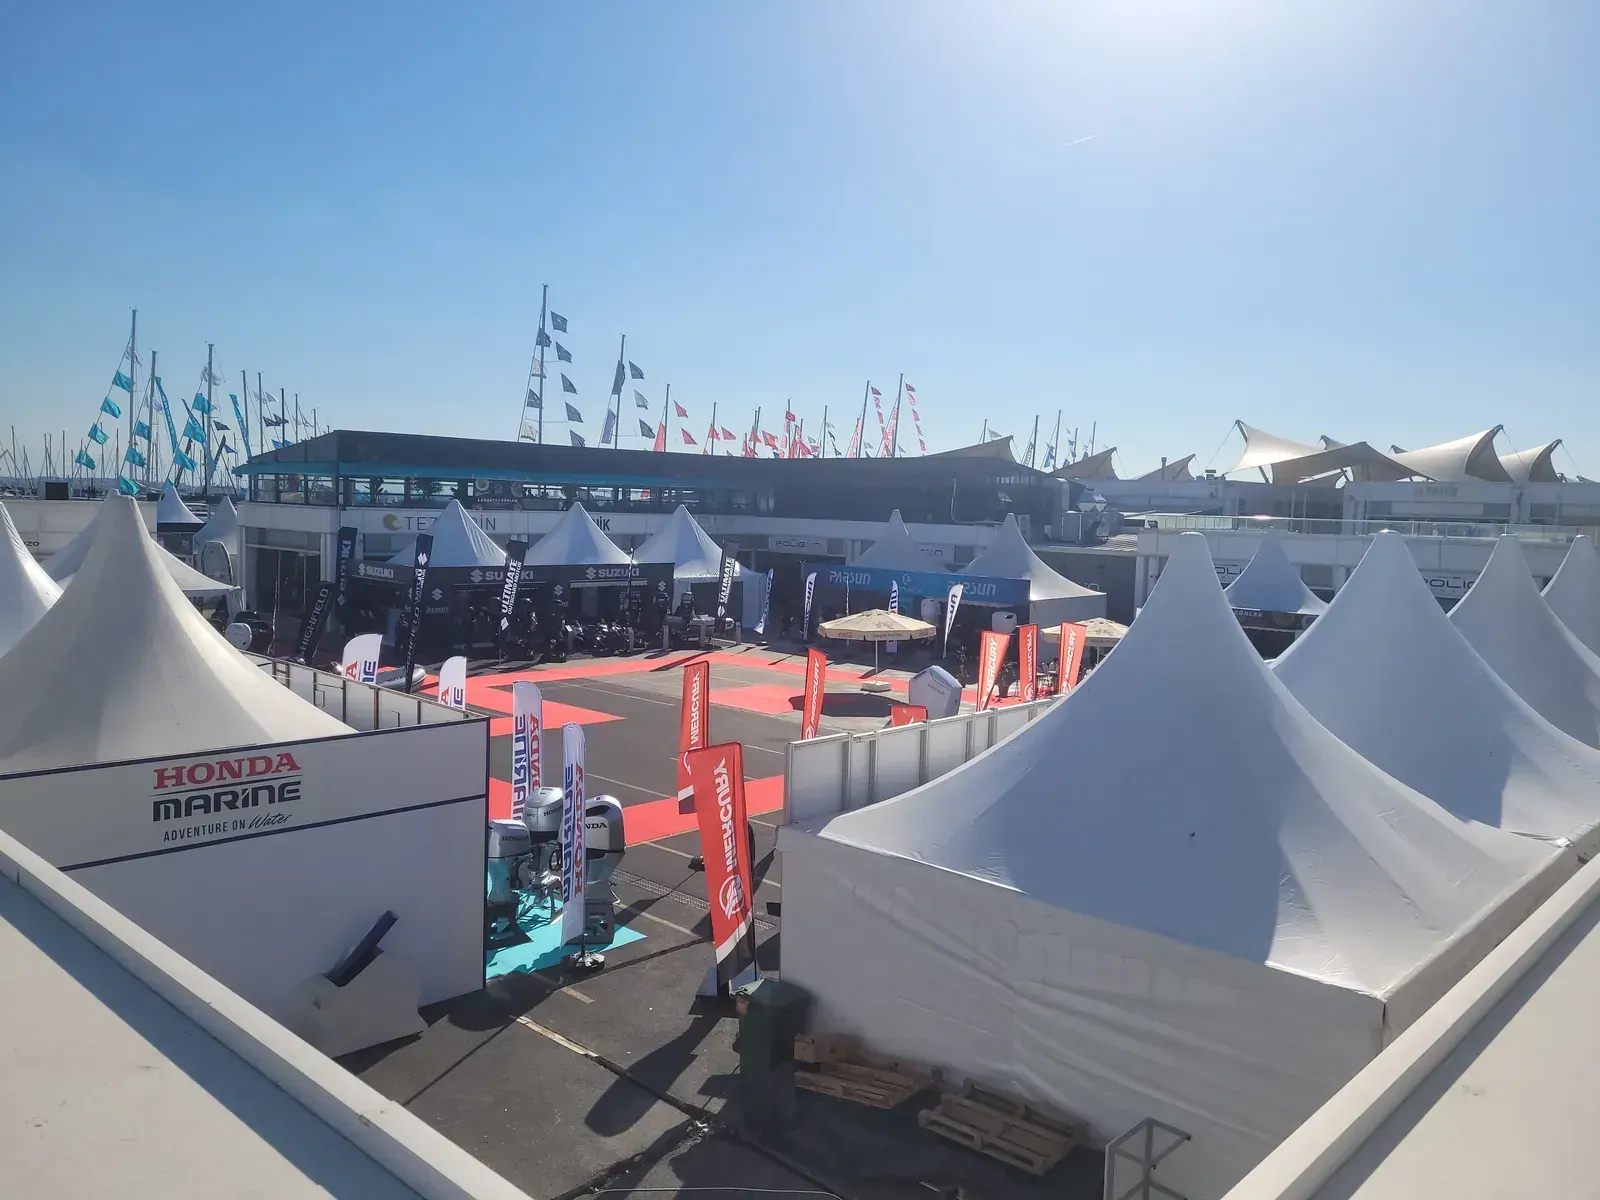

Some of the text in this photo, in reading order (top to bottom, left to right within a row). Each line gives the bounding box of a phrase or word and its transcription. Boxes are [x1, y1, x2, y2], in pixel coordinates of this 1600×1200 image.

[366, 566, 394, 578] SUZUKI
[484, 570, 534, 580] SUKI
[501, 559, 519, 614] ULTIMATE
[598, 567, 640, 577] SUZUKI
[719, 556, 735, 603] ULTIMATE
[946, 580, 996, 597] PRSUN
[300, 588, 329, 653] HIGHFIELD
[986, 638, 1000, 694] MERCURY
[1064, 628, 1078, 681] MERCURY
[810, 657, 820, 723] MERCURY
[153, 752, 302, 789] HONDA
[152, 781, 302, 822] MARINE
[543, 804, 563, 816] HOND
[163, 812, 293, 842] ADVENTURE ON Water
[584, 822, 608, 830] NDA
